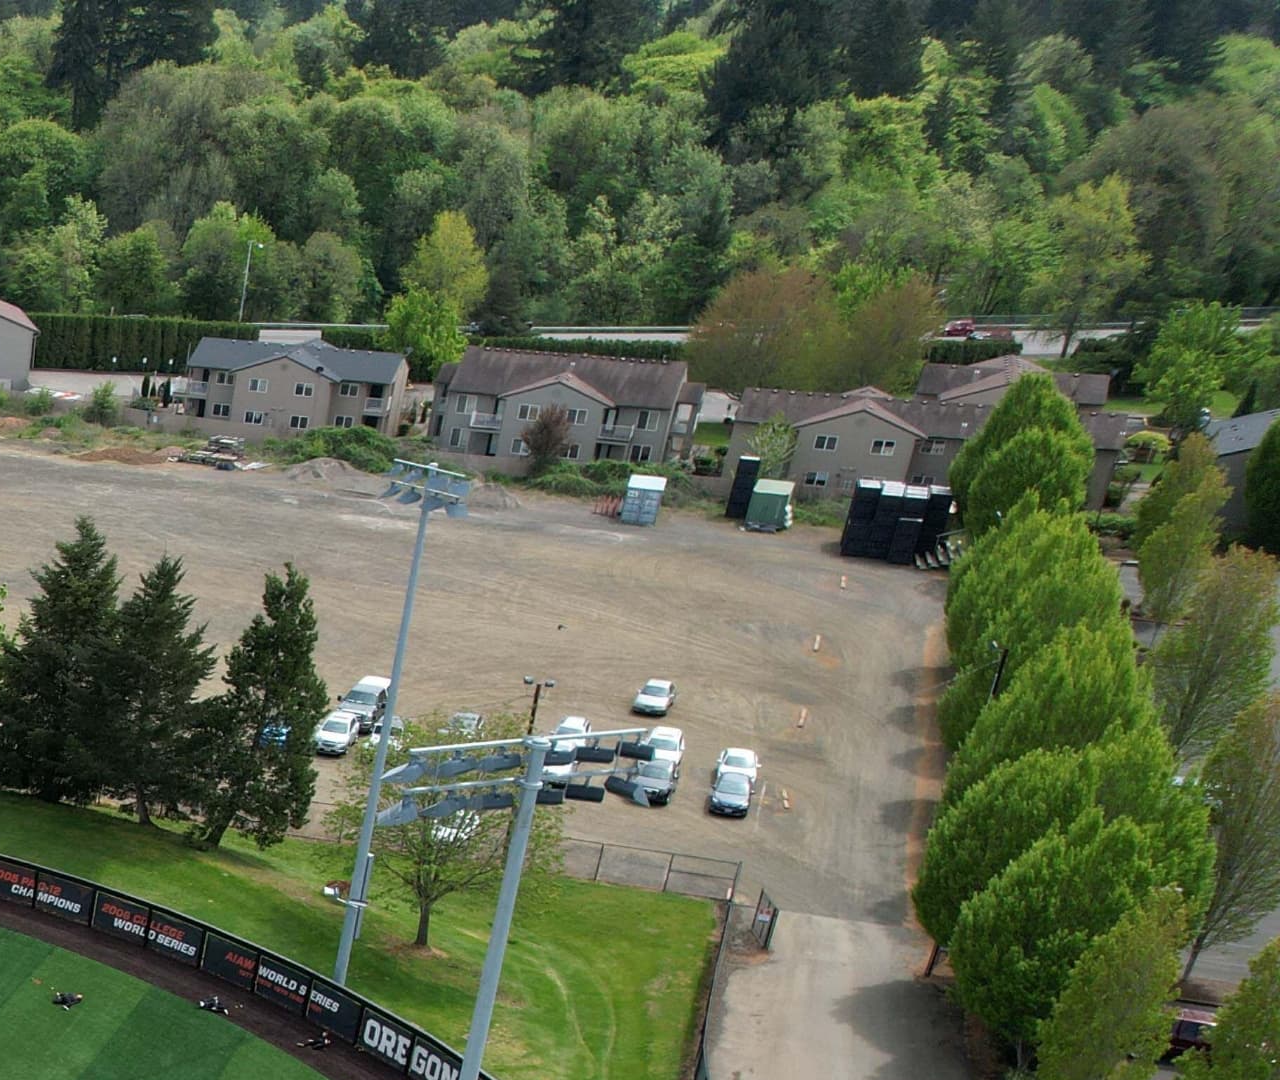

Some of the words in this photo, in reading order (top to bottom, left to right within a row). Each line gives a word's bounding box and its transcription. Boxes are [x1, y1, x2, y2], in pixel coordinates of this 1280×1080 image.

[11, 883, 82, 914] CHAMPIONS
[113, 917, 156, 941] WORLD
[156, 934, 197, 957] SERIES
[133, 912, 186, 941] COLLEGE
[225, 951, 256, 970] AIAW
[258, 965, 297, 991] WORLD
[298, 985, 341, 1014] SERIES
